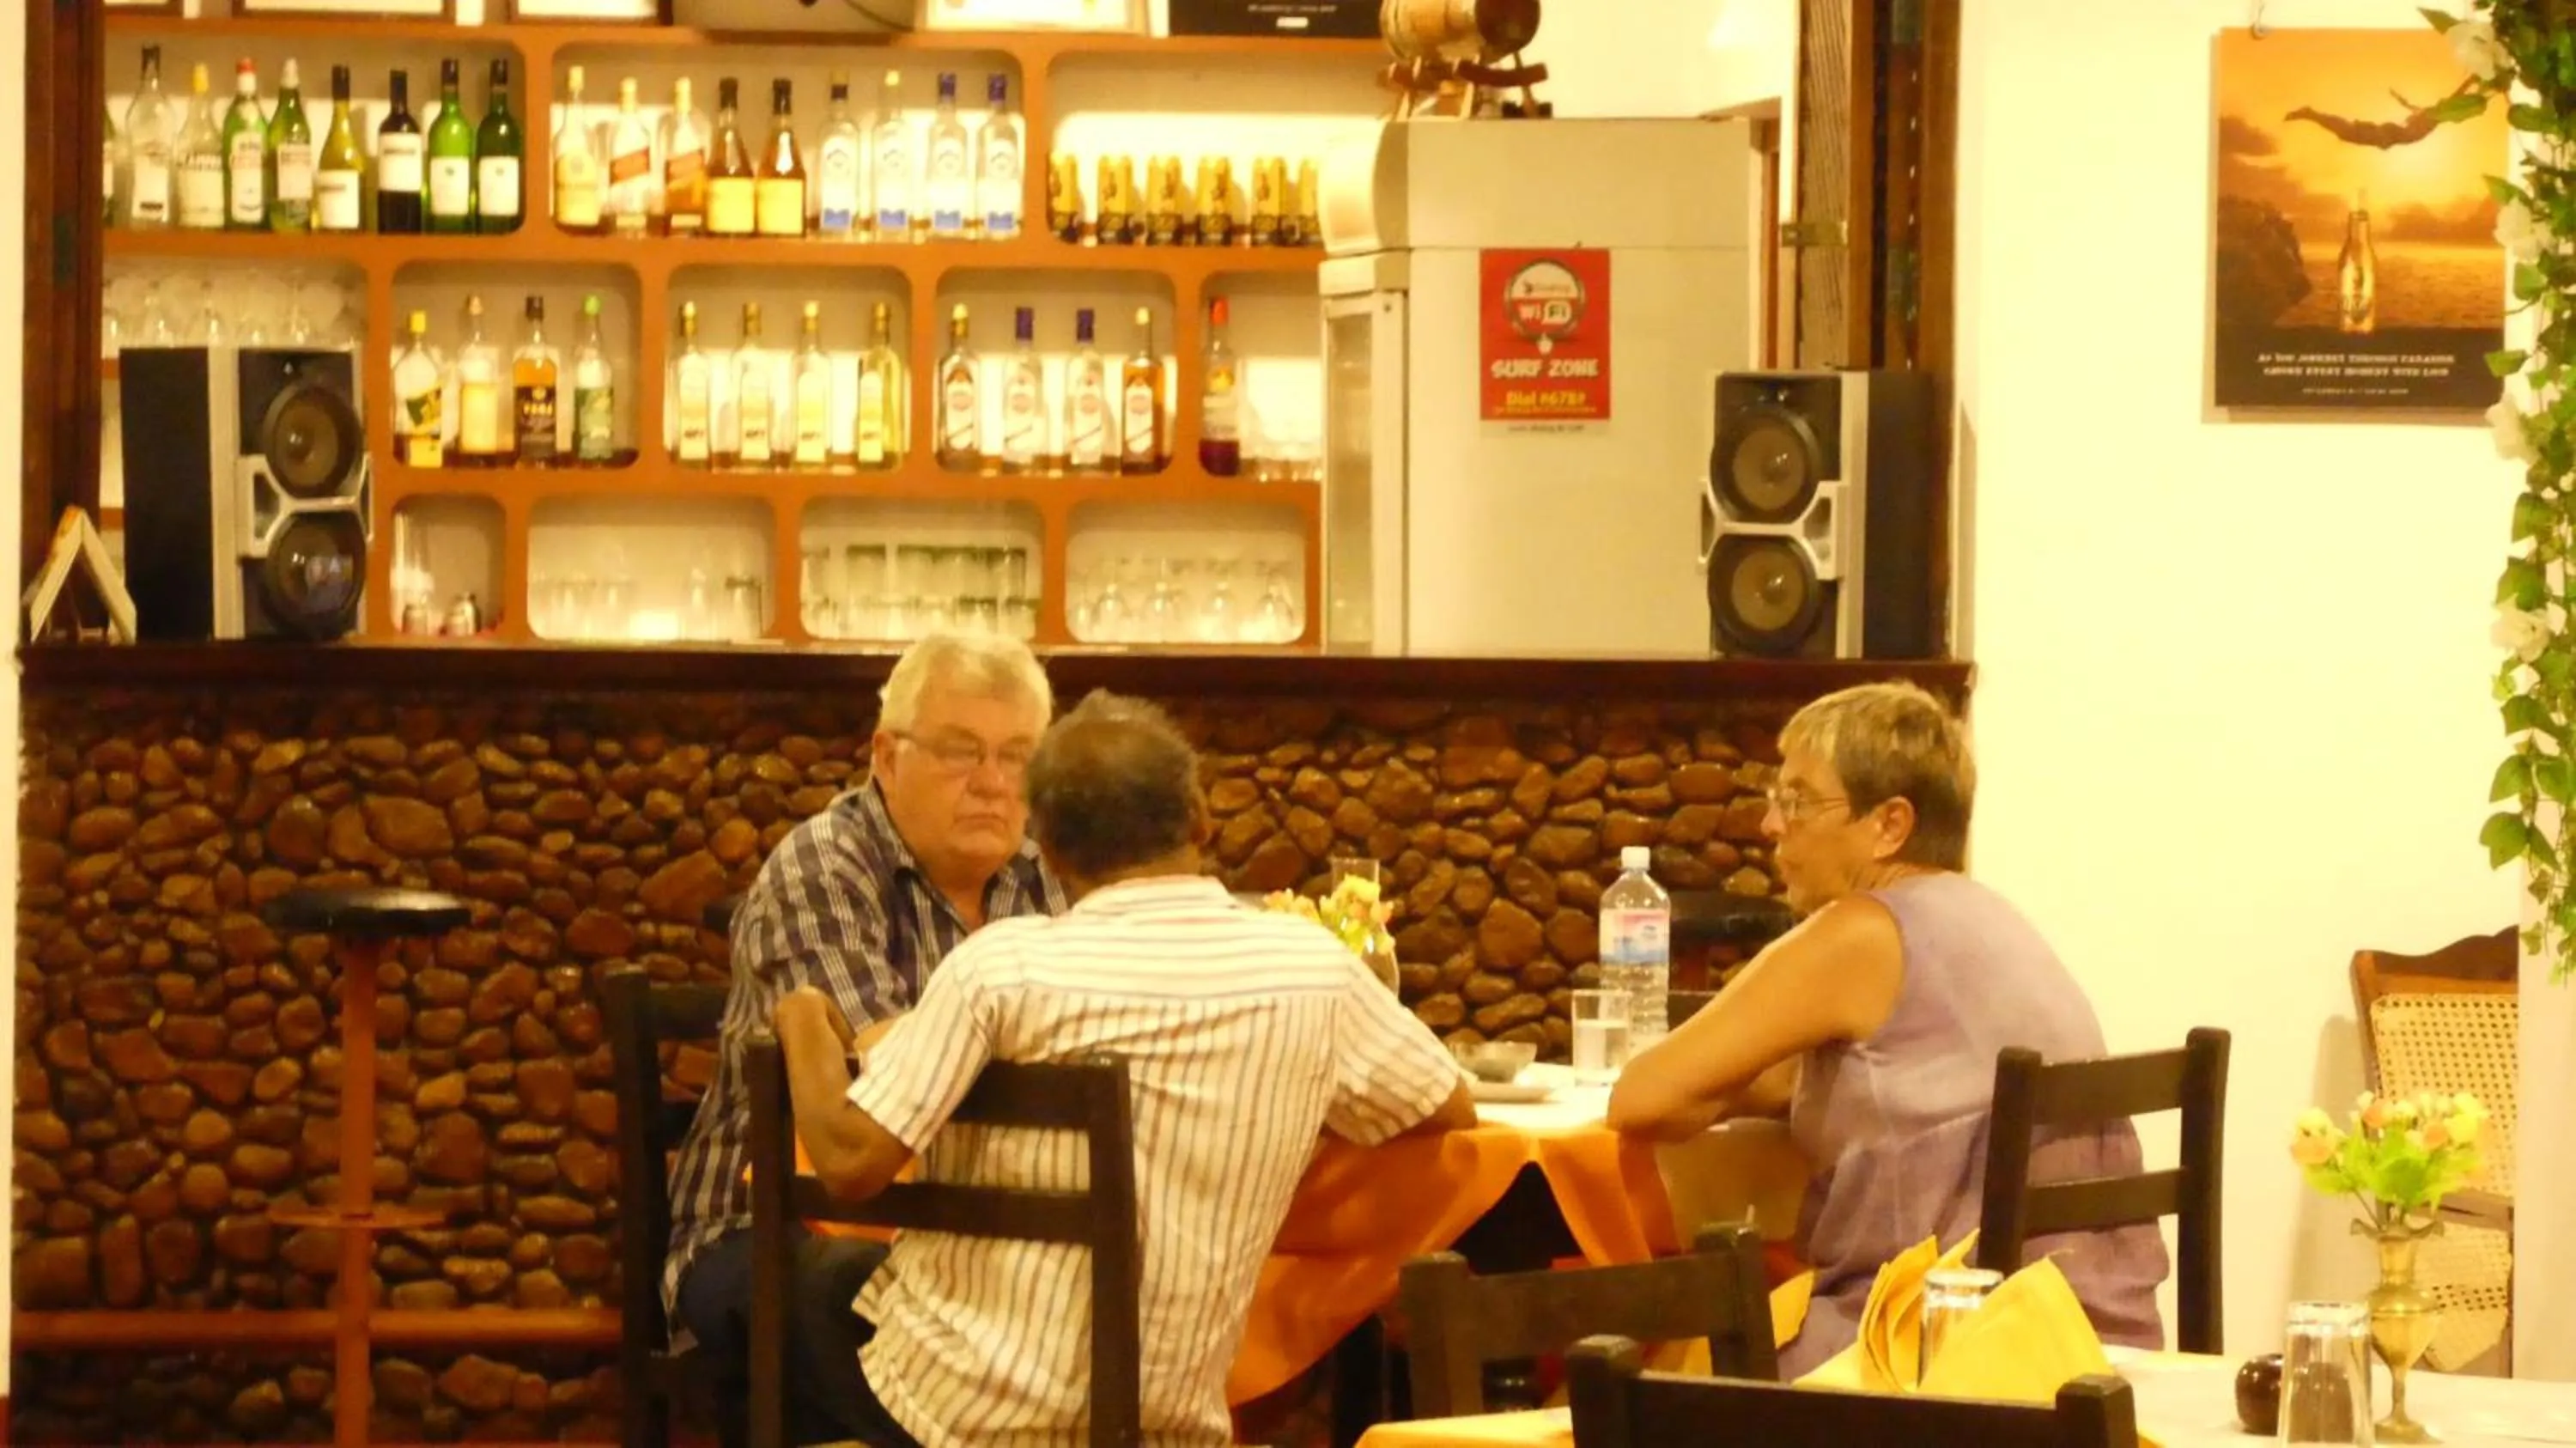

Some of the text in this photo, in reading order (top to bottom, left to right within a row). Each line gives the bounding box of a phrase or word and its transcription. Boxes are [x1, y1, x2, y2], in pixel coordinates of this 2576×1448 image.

[1491, 358, 1599, 378] SURF ZONE
[1506, 390, 1537, 405] Dial
